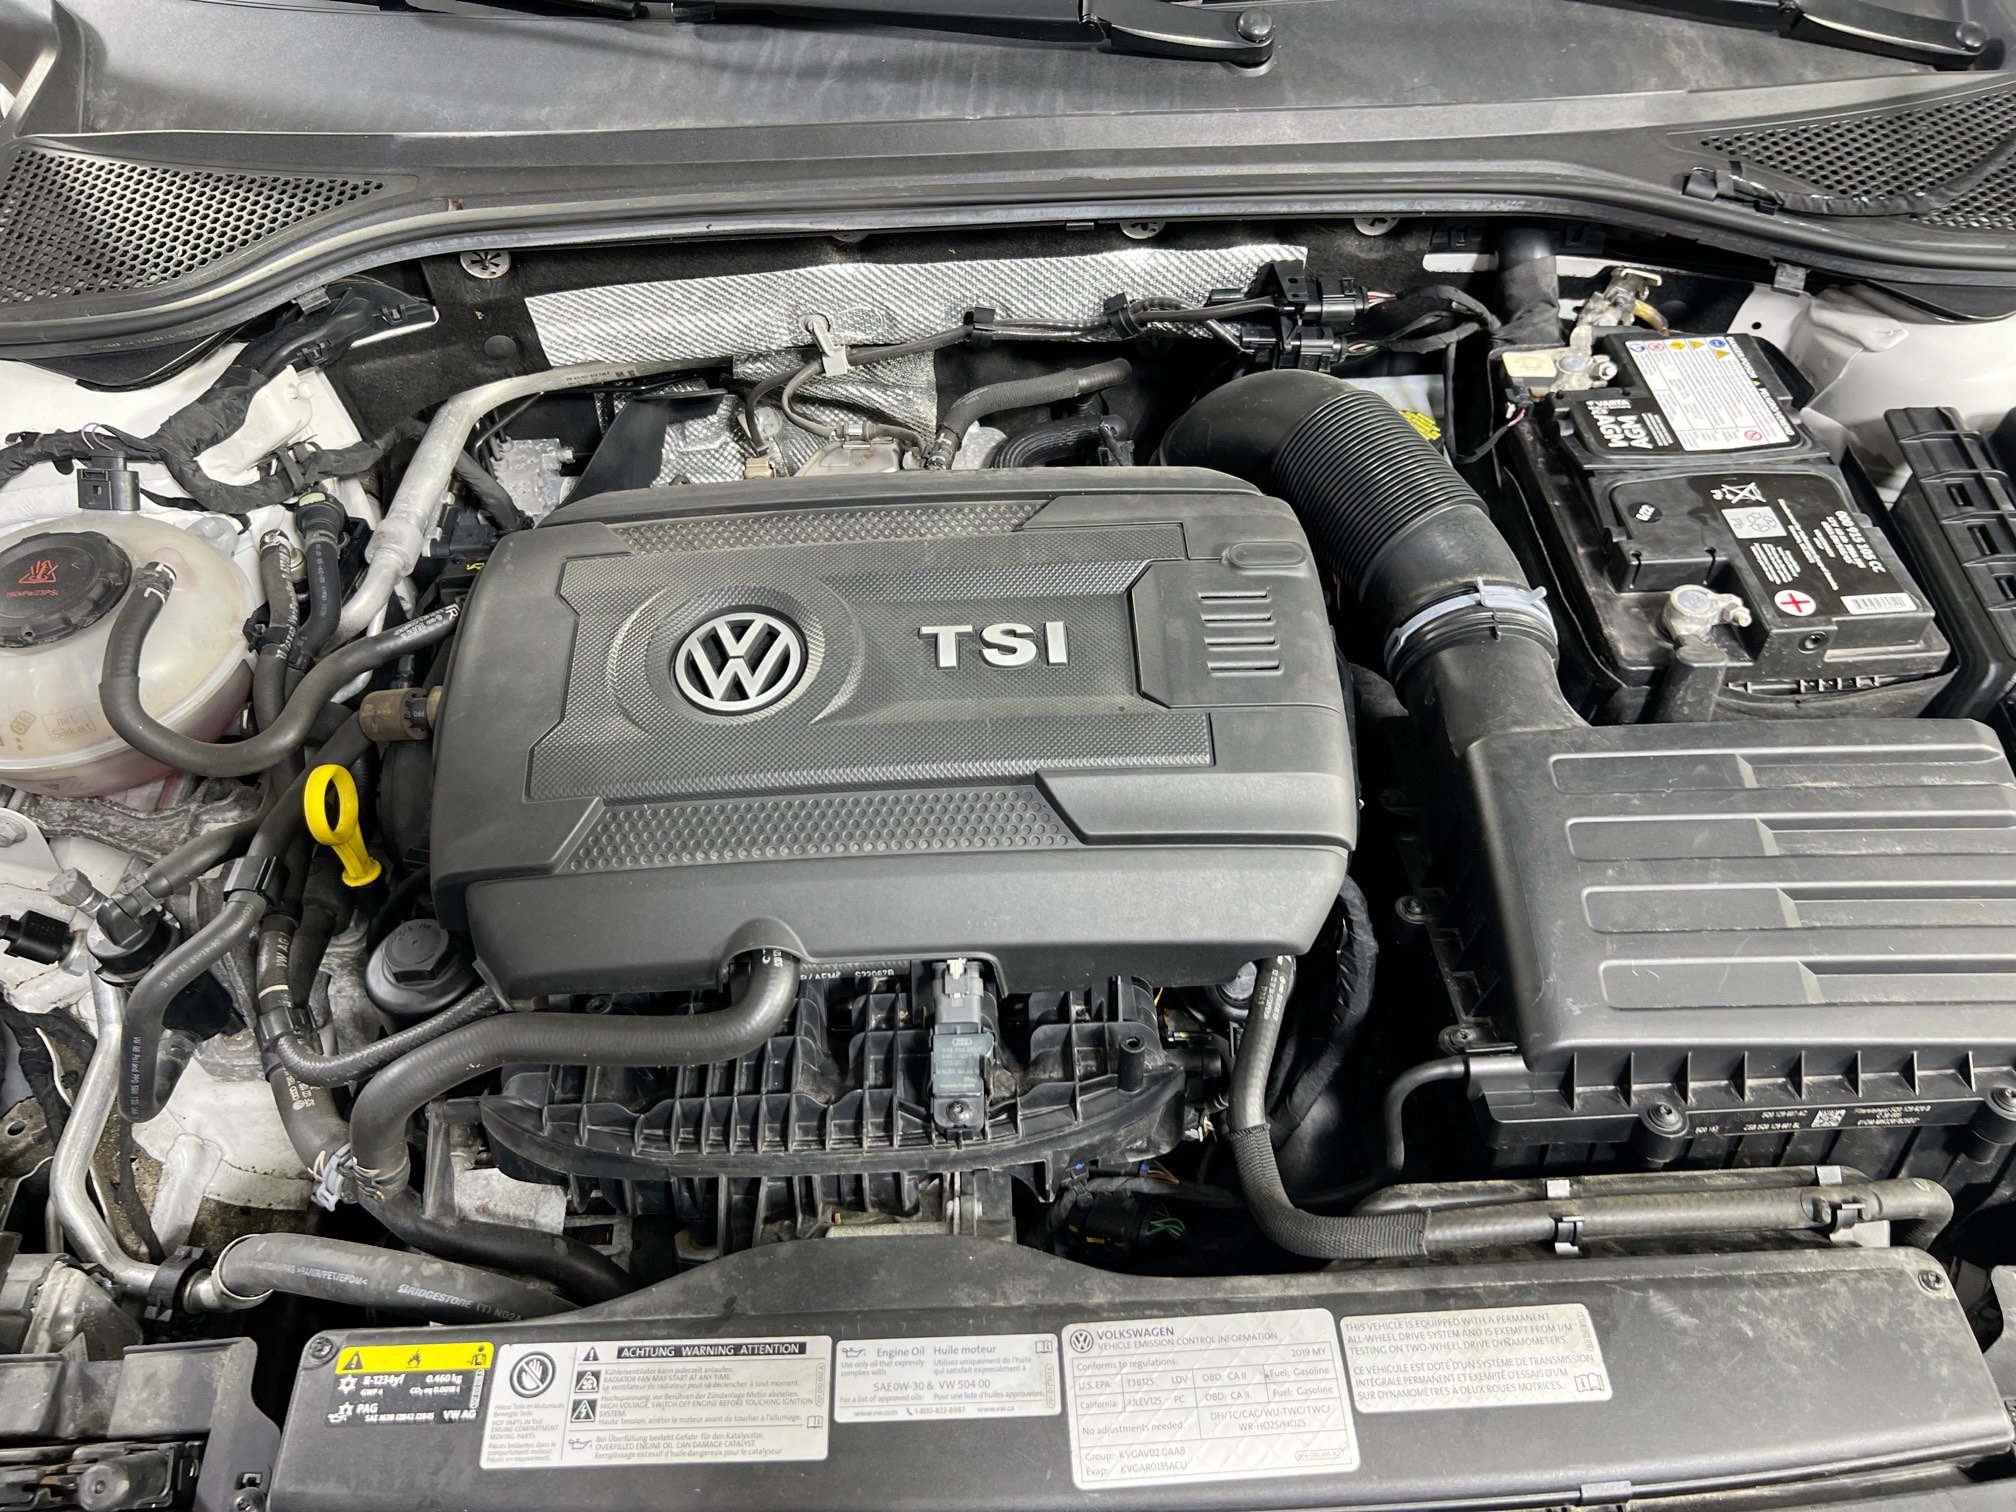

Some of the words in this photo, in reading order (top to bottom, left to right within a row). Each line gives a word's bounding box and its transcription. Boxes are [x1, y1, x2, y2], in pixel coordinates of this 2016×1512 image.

[1593, 414, 1629, 448] AGM
[1617, 415, 1654, 449] AGM
[1835, 511, 1855, 527] 000
[1846, 527, 1866, 543] 915
[918, 621, 1068, 670] TSI
[52, 723, 93, 739] Silikat
[397, 1284, 473, 1308] BRIDGESTONE
[1345, 1323, 1366, 1332] THIS
[1367, 1321, 1403, 1332] VEHICLE
[1405, 1320, 1414, 1329] IS
[1415, 1317, 1460, 1329] EQUIPPED
[1460, 1316, 1486, 1326] WITH
[1488, 1316, 1495, 1324] A
[1496, 1312, 1550, 1324] PERMANENT
[1096, 1326, 1175, 1340] VOLKSWAGEN
[1348, 1333, 1398, 1344] ALL-WHEEL
[1398, 1331, 1426, 1341] DRIVE
[1427, 1329, 1460, 1339] SYSTEM
[1462, 1328, 1482, 1337] AND
[1484, 1327, 1493, 1336] IS
[1494, 1325, 1528, 1336] EXEMPT
[1530, 1324, 1557, 1333] FROM
[1097, 1340, 1132, 1351] VEHICLE
[1134, 1338, 1175, 1349] EMISSION
[1176, 1335, 1216, 1346] CONTROL
[1217, 1332, 1278, 1343] INFORMATION
[1348, 1345, 1387, 1355] TESTING
[1388, 1344, 1404, 1353] ON
[1405, 1341, 1462, 1353] TWO-WHEEL
[1463, 1339, 1489, 1349] DRIVE
[1491, 1335, 1569, 1347] DYNAMOMETERS.
[621, 1346, 675, 1358] ACHTUNG
[681, 1345, 735, 1356] WARNING
[740, 1343, 800, 1355] ATTENTION
[877, 1347, 909, 1358] Engine
[911, 1346, 924, 1356] Oil
[934, 1345, 959, 1355] Huile
[961, 1345, 997, 1354] moteur
[854, 1360, 868, 1369] only
[879, 1359, 893, 1367] that
[894, 1359, 925, 1368] expressly
[934, 1358, 958, 1366] Utilisez
[960, 1357, 1000, 1367] uniquement
[1077, 1360, 1117, 1371] Conforms
[1119, 1361, 1127, 1369] to
[1129, 1357, 1178, 1370] regulations:
[1291, 1348, 1310, 1357] 2019
[1312, 1347, 1326, 1356] MY
[1353, 1366, 1364, 1375] CE
[1410, 1362, 1425, 1372] EST
[1452, 1360, 1475, 1370] D'UN
[1515, 1357, 1528, 1366] DE
[1529, 1353, 1595, 1366] TRANSMISSION
[841, 1370, 870, 1378] complies
[870, 1368, 887, 1376] with
[933, 1367, 945, 1376] qui
[946, 1366, 972, 1374] satisfait
[1079, 1380, 1094, 1390] U.S.
[1126, 1377, 1154, 1388] T3B125
[1171, 1375, 1188, 1384] LDV
[1227, 1371, 1240, 1380] CA
[1293, 1366, 1330, 1376] Gasoline
[1403, 1373, 1455, 1385] PERMANENT
[1456, 1372, 1467, 1382] ET
[1508, 1368, 1544, 1380] D'ESSAIS
[362, 1374, 406, 1388] R-1234yf
[425, 1374, 451, 1384] 0.460
[451, 1373, 463, 1384] kg
[926, 1380, 934, 1390] &
[938, 1380, 956, 1389] VW
[958, 1379, 976, 1389] 504
[978, 1379, 991, 1388] 00
[877, 1394, 909, 1403] approved
[963, 1391, 978, 1399] liste
[979, 1390, 1004, 1398] d'huiles
[1080, 1398, 1119, 1410] California:
[1127, 1396, 1162, 1407] ULEV125
[1174, 1394, 1185, 1404] PC
[1230, 1391, 1243, 1400] CA
[1296, 1385, 1334, 1396] Gasoline
[1357, 1390, 1376, 1401] SUR
[1460, 1385, 1486, 1395] DEUX
[1486, 1382, 1517, 1393] ROUES
[1518, 1380, 1564, 1392] MOTRICES.
[356, 1403, 379, 1414] PAG
[442, 1409, 461, 1419] VW
[461, 1409, 477, 1419] AG
[854, 1409, 898, 1417] www.vw.com
[1082, 1427, 1095, 1436] No
[1096, 1424, 1149, 1436] adjustments
[1151, 1420, 1183, 1431] needed
[663, 1441, 673, 1449] OIL
[692, 1440, 722, 1448] DAMAGE
